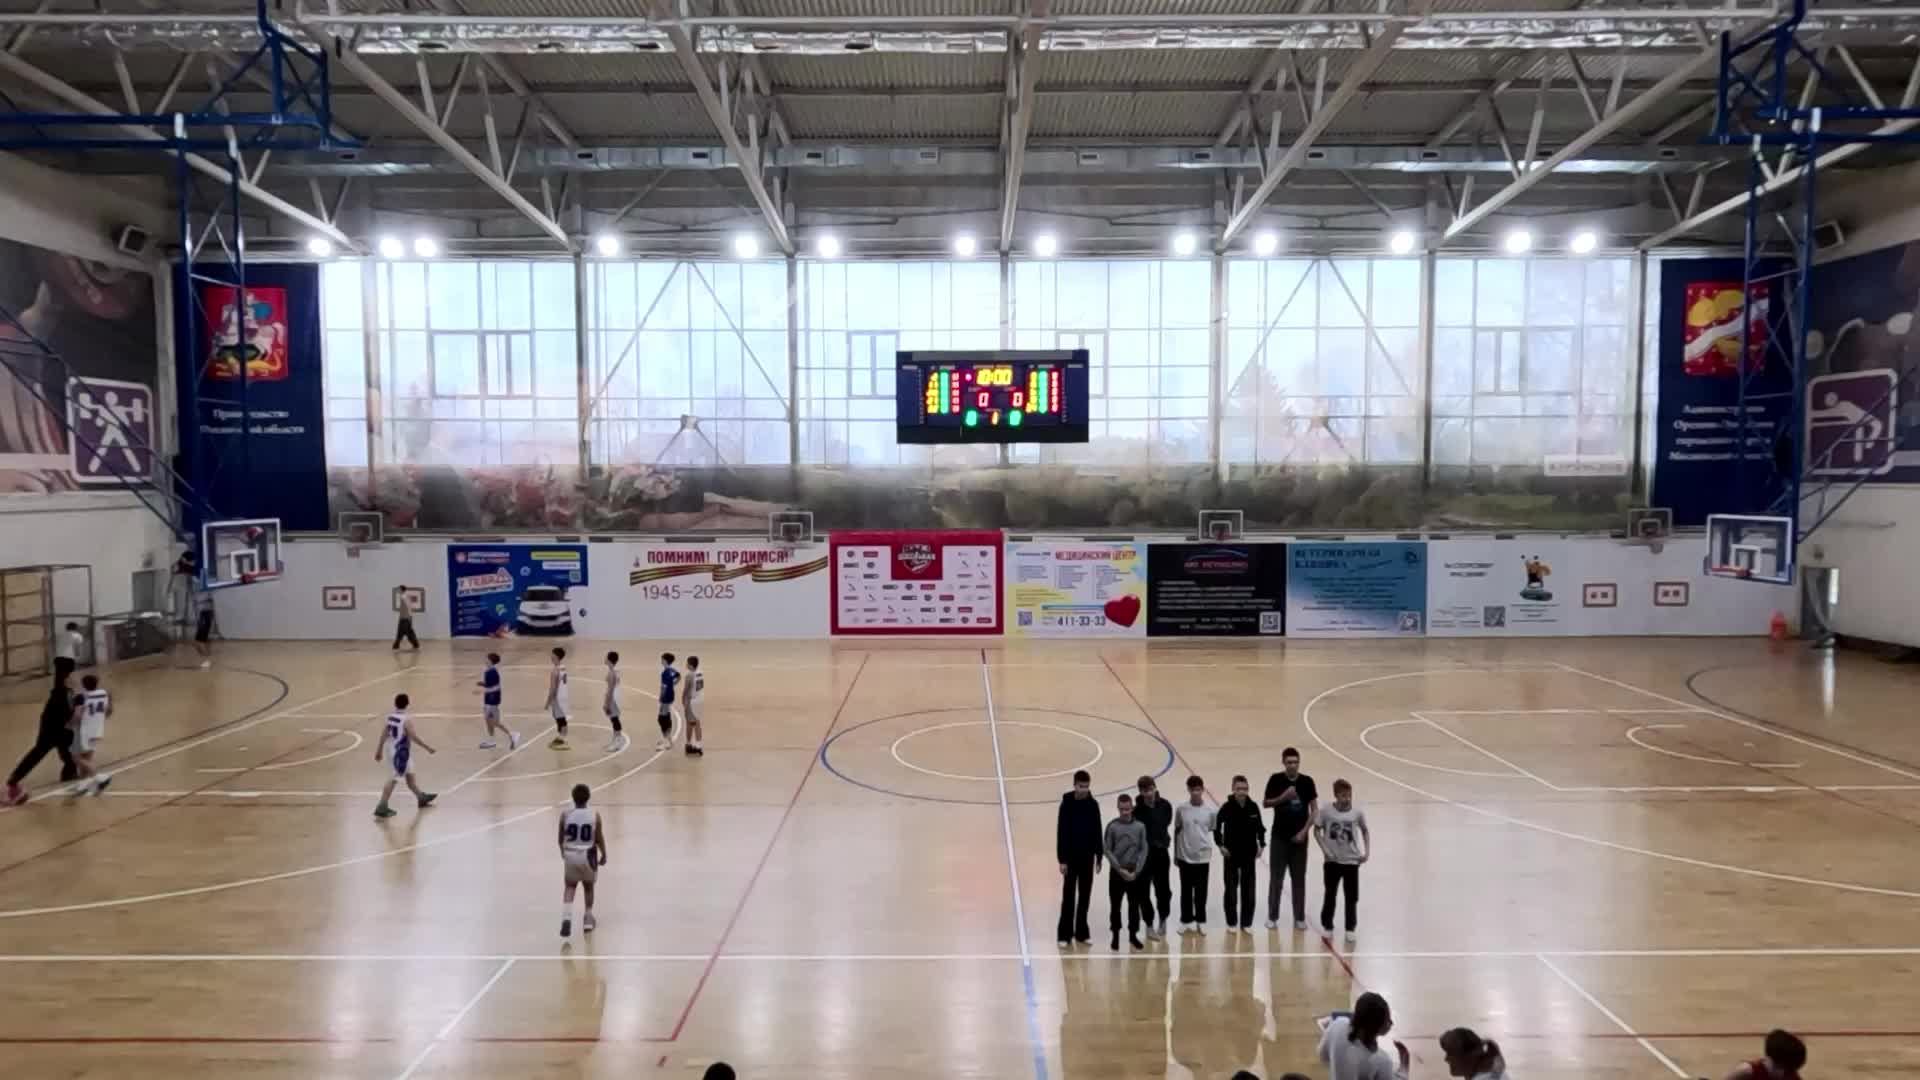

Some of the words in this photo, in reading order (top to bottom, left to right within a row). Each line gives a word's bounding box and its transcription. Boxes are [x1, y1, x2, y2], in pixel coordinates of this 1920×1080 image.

[978, 391, 990, 407] 0
[1012, 391, 1024, 407] 0
[647, 550, 710, 564] ПОМНИМ!
[717, 550, 789, 565] ГОРДИМСЯ!
[642, 584, 736, 600] 1945-2025
[1057, 615, 1106, 627] 411-33-33
[88, 701, 105, 716] 14
[565, 823, 593, 843] 90
